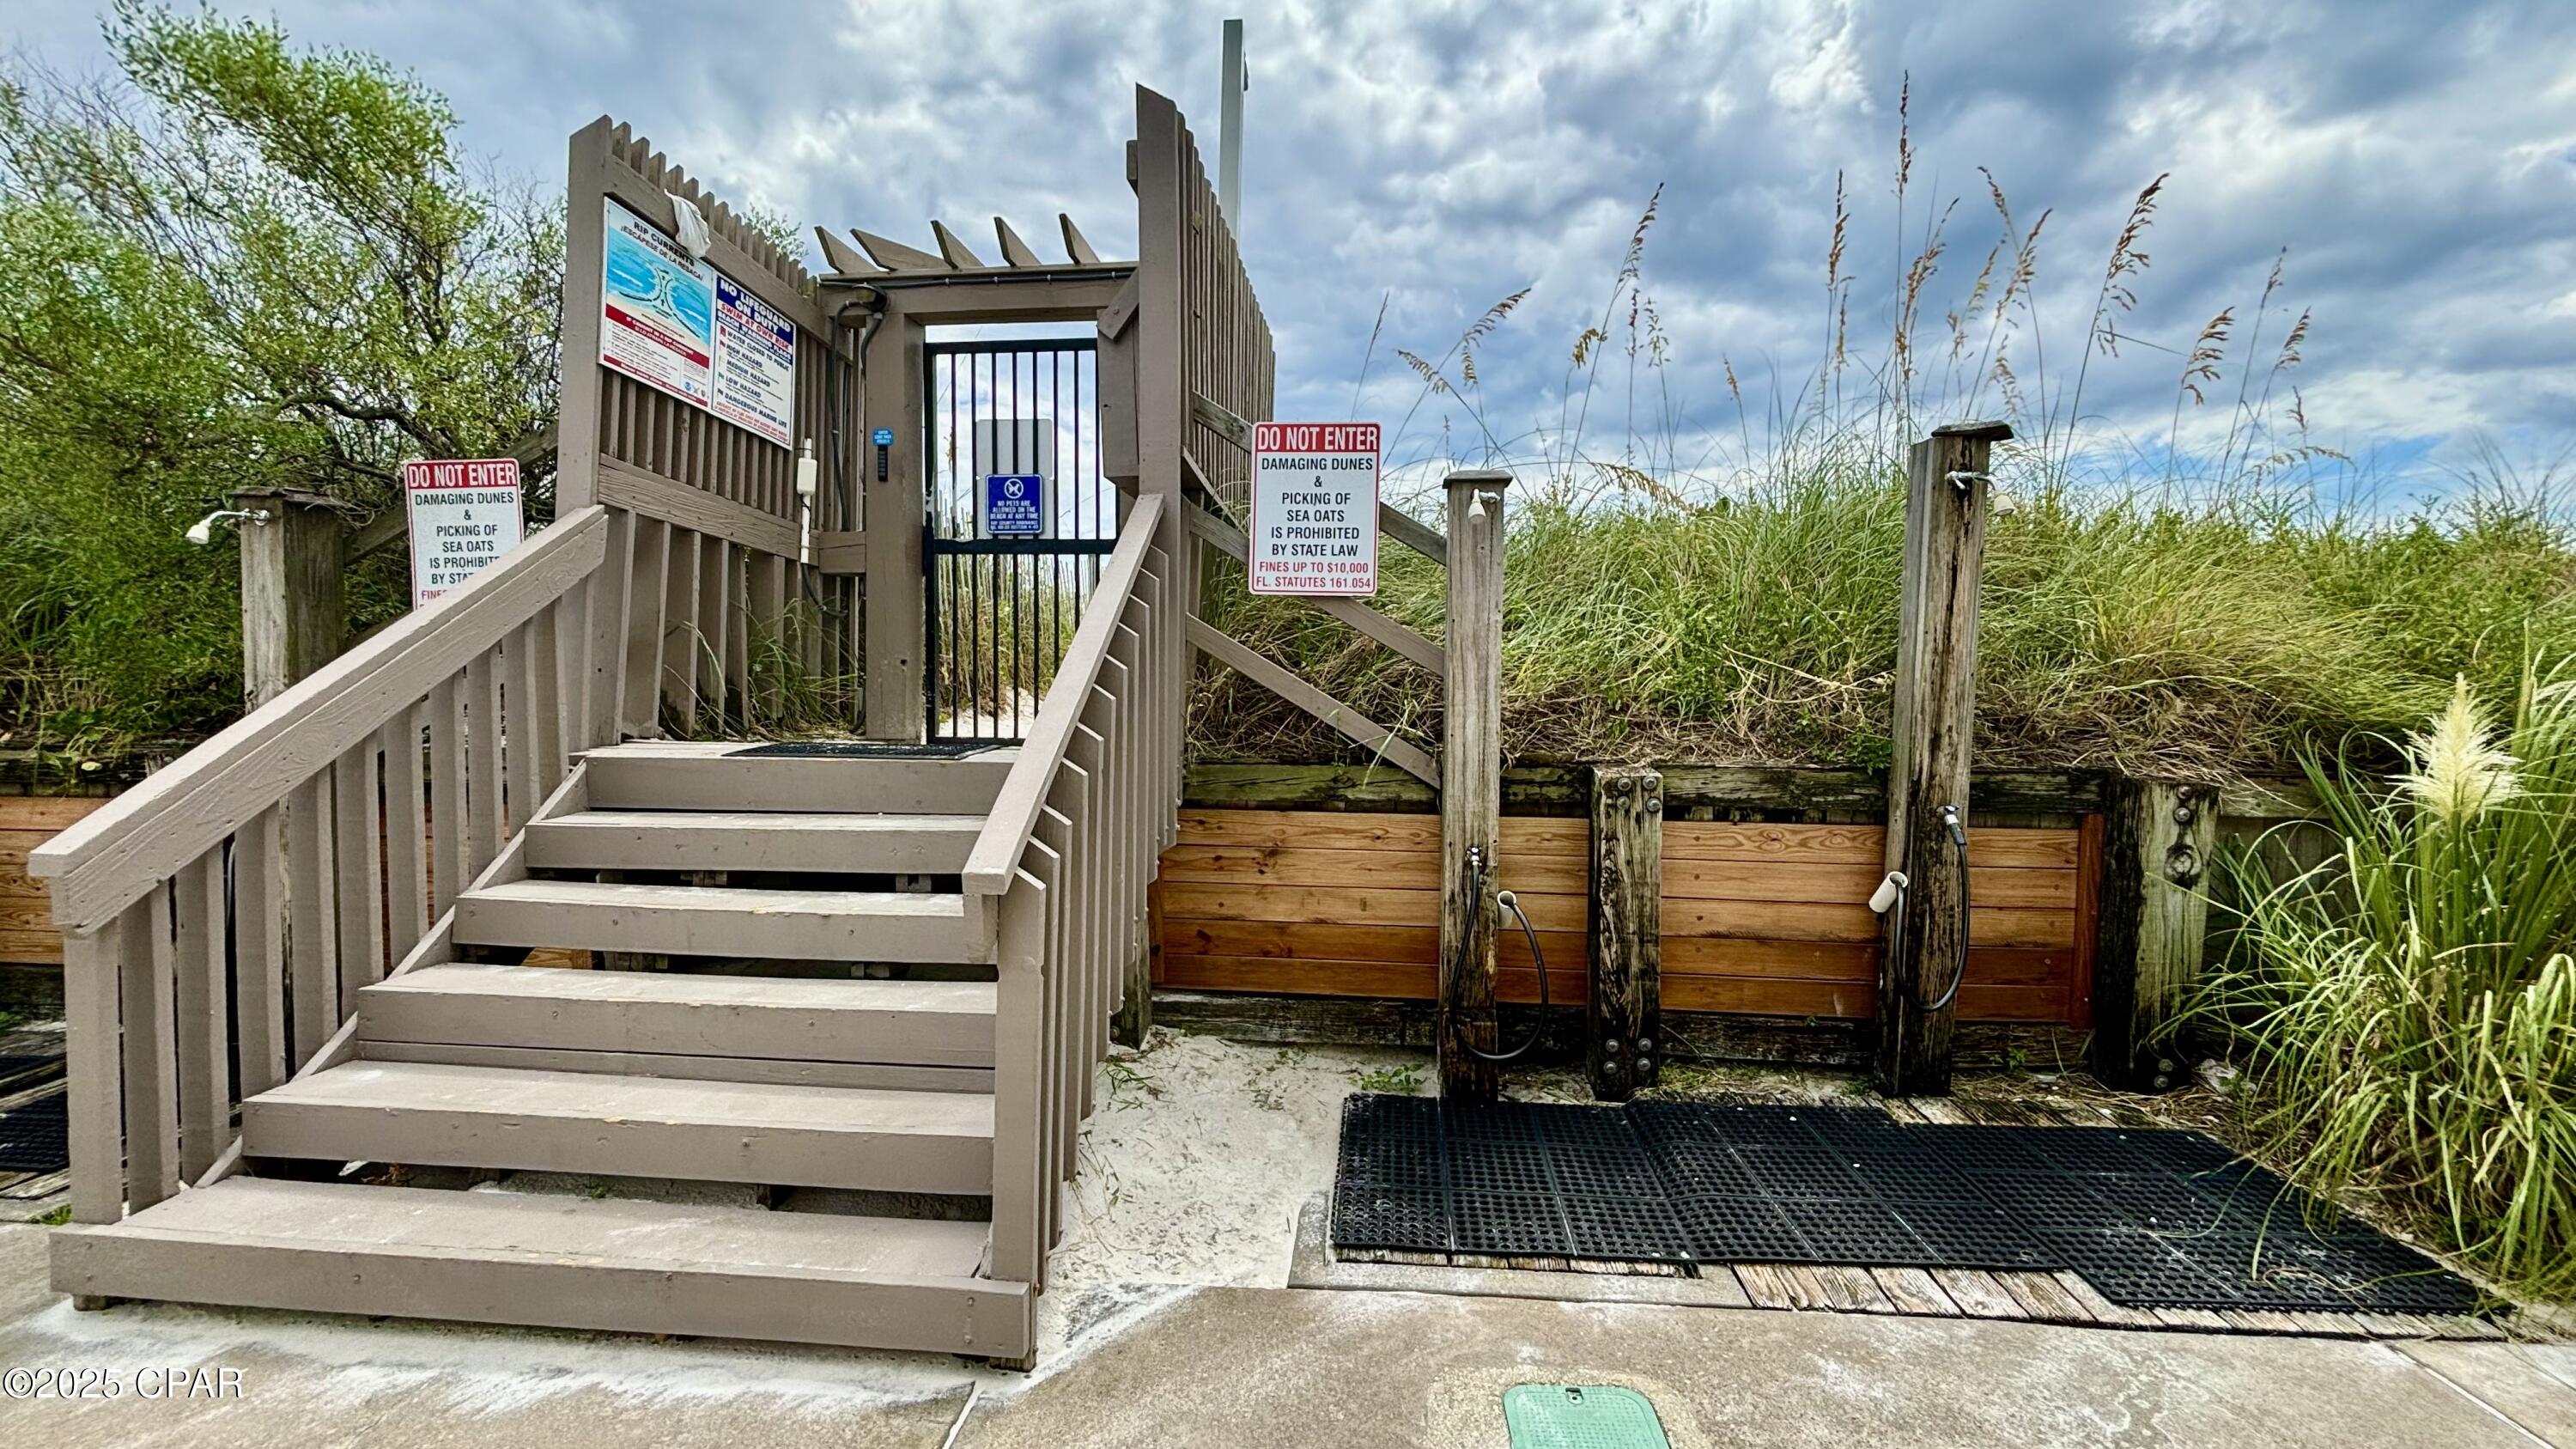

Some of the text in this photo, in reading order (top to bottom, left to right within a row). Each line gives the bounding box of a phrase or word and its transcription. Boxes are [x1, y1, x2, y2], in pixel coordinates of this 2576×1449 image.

[634, 222, 695, 267] RIP CURRENTS
[659, 249, 668, 259] DE
[669, 255, 677, 265] LA
[720, 279, 791, 332] NO LIFEGUARD
[735, 300, 779, 333] ON DUTY
[721, 303, 790, 350] SWIM AT OWN RISK
[718, 310, 739, 327] BEACH
[741, 325, 772, 347] WARNING
[773, 344, 791, 359] FLAGS
[726, 344, 740, 356] HIGH
[741, 352, 762, 368] HAZARD
[727, 330, 745, 345] WATER
[747, 342, 765, 356] CLOSED
[774, 359, 789, 372] PUBLIC
[726, 359, 749, 374] MEDIUM
[750, 373, 770, 387] HAZARD
[726, 375, 738, 386] LOW
[740, 382, 762, 398] HAZARD
[725, 393, 757, 412] DANGEROUS
[759, 409, 777, 423] MARINE
[778, 419, 787, 428] LIFE
[1257, 426, 1377, 451] DO NOT ENTER
[1261, 458, 1373, 471] DAMAGING DUNES
[408, 462, 517, 488] DO NOT ENTER
[1314, 475, 1322, 488] &
[415, 491, 514, 506] DAMAGING DUNES
[1282, 493, 1352, 505] PICKING OF
[464, 509, 472, 520] &
[1286, 510, 1345, 522] SEA OATS
[436, 524, 498, 537] PICKING OF
[1271, 527, 1360, 539] IS PROHIBITED
[442, 540, 494, 552] SEA OATS
[1272, 545, 1358, 557] BY STATE LAW
[429, 556, 500, 569] IS PROHIBIT
[1259, 562, 1369, 574] FINES UP TO $10,000
[432, 572, 474, 584] BY STA
[1256, 576, 1371, 588] FL. STATUTES 161.054
[421, 589, 447, 600] FINE
